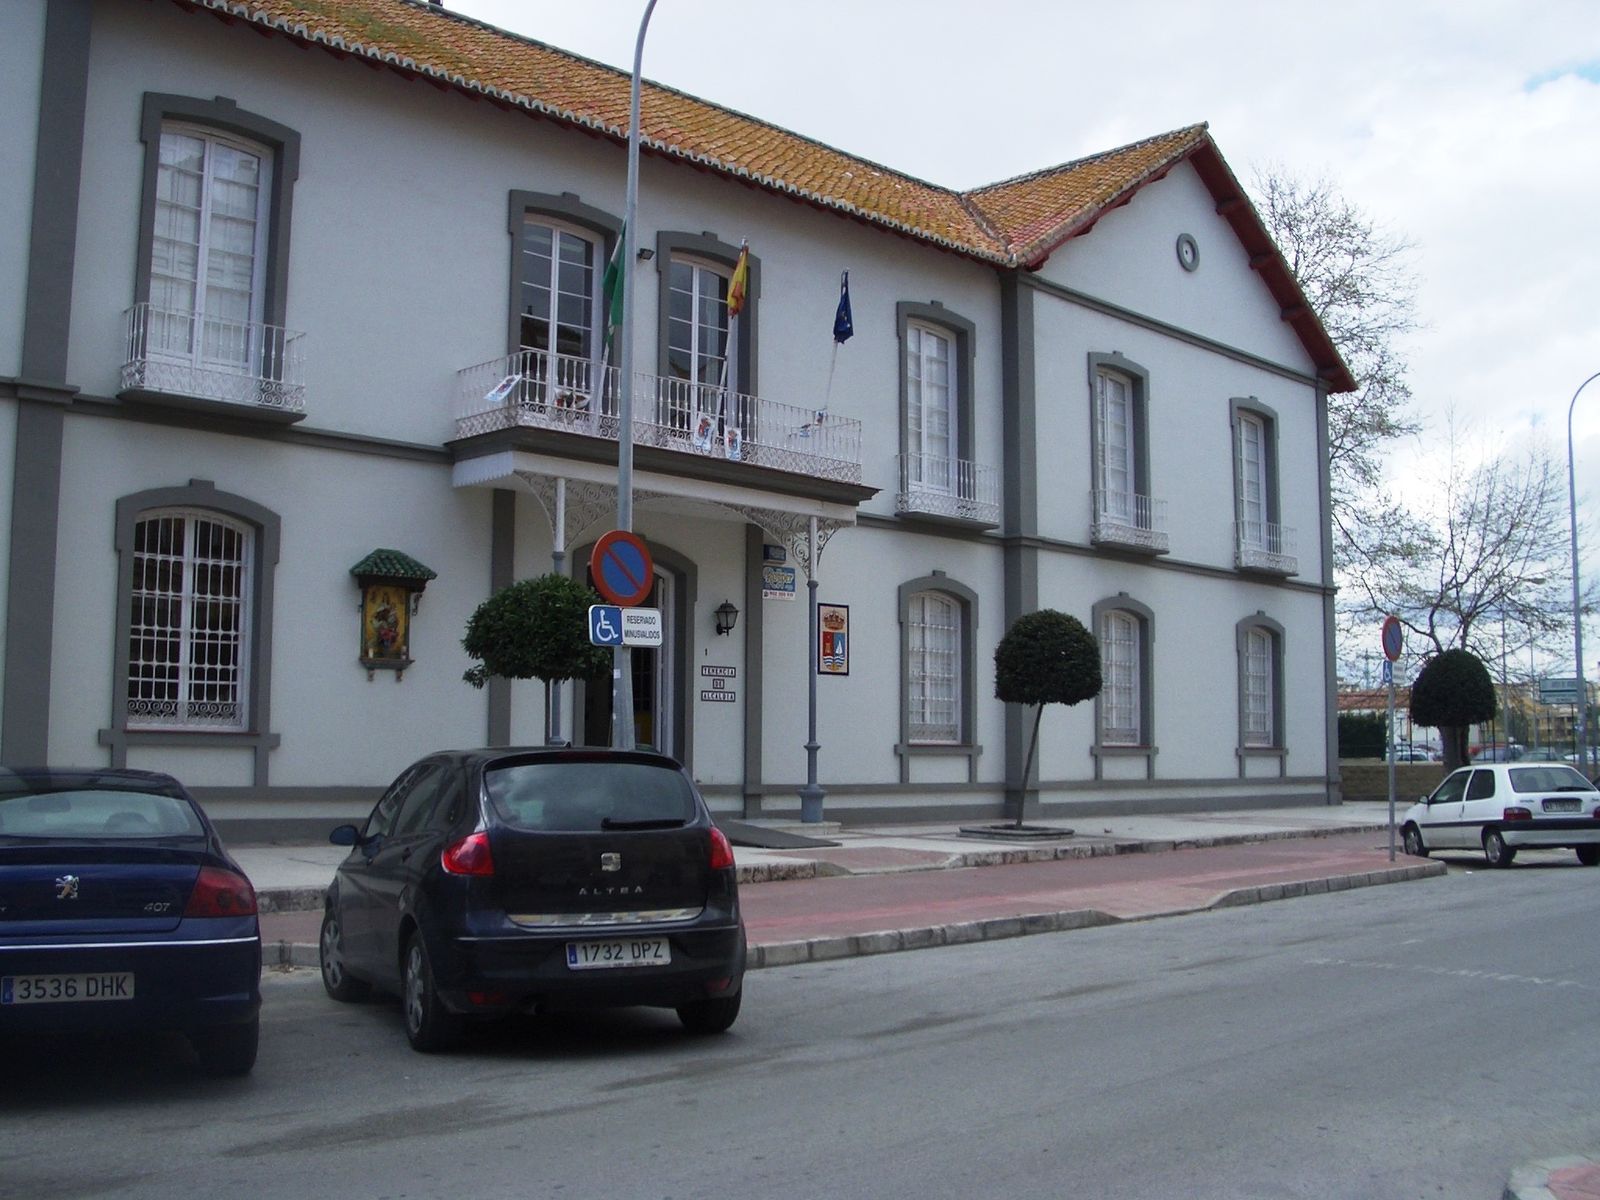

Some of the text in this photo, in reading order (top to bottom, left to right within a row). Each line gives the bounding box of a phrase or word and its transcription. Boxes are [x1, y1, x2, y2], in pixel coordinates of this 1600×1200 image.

[626, 615, 656, 625] RESERVADO
[624, 629, 660, 639] MINUSVALIDOS
[579, 886, 643, 895] ALTEA
[144, 902, 170, 912] 407
[582, 942, 663, 962] 1732 DPZ
[18, 976, 127, 999] 3536 DHK
